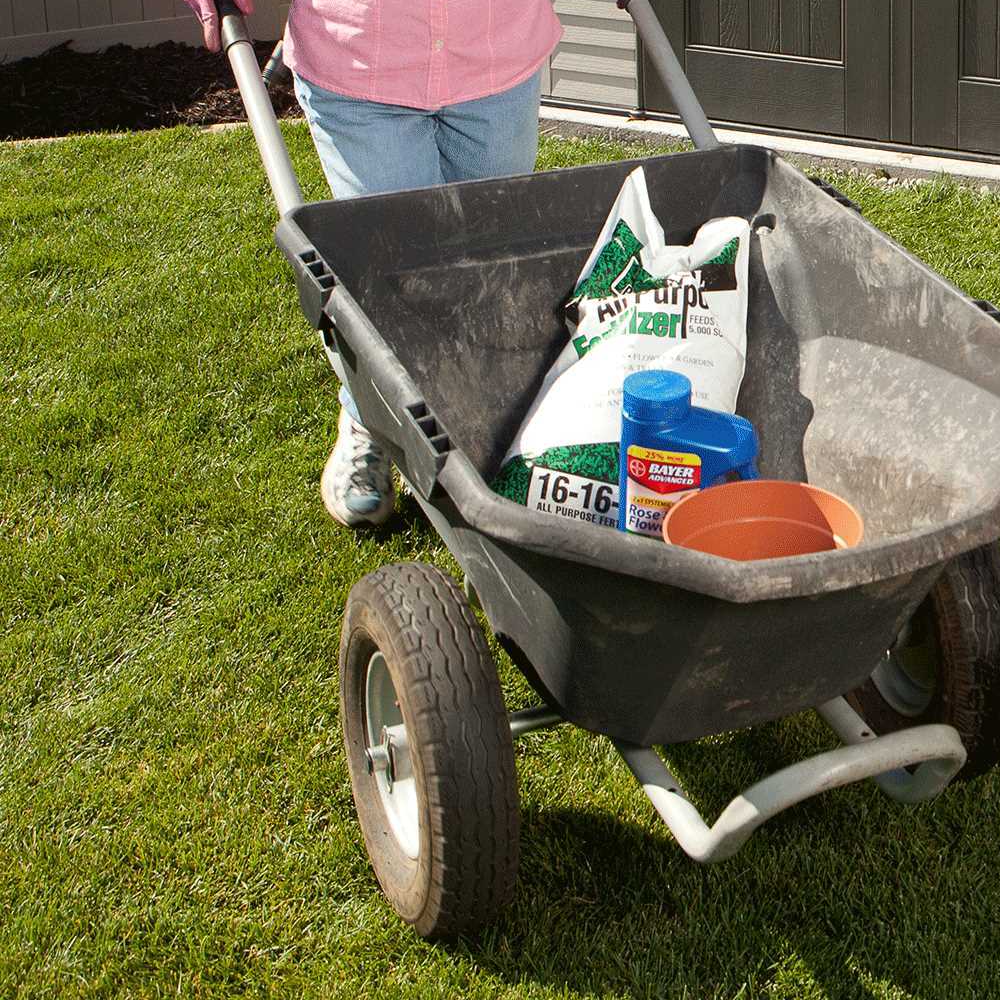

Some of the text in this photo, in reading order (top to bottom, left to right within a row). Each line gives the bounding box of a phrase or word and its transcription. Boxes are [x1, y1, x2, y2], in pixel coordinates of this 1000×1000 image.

[689, 314, 716, 326] FEEDS
[648, 463, 695, 478] BAYER
[647, 474, 694, 485] ADVANCED
[536, 502, 552, 514] ALL
[555, 505, 598, 523] PURPOSE
[629, 504, 661, 521] Rose
